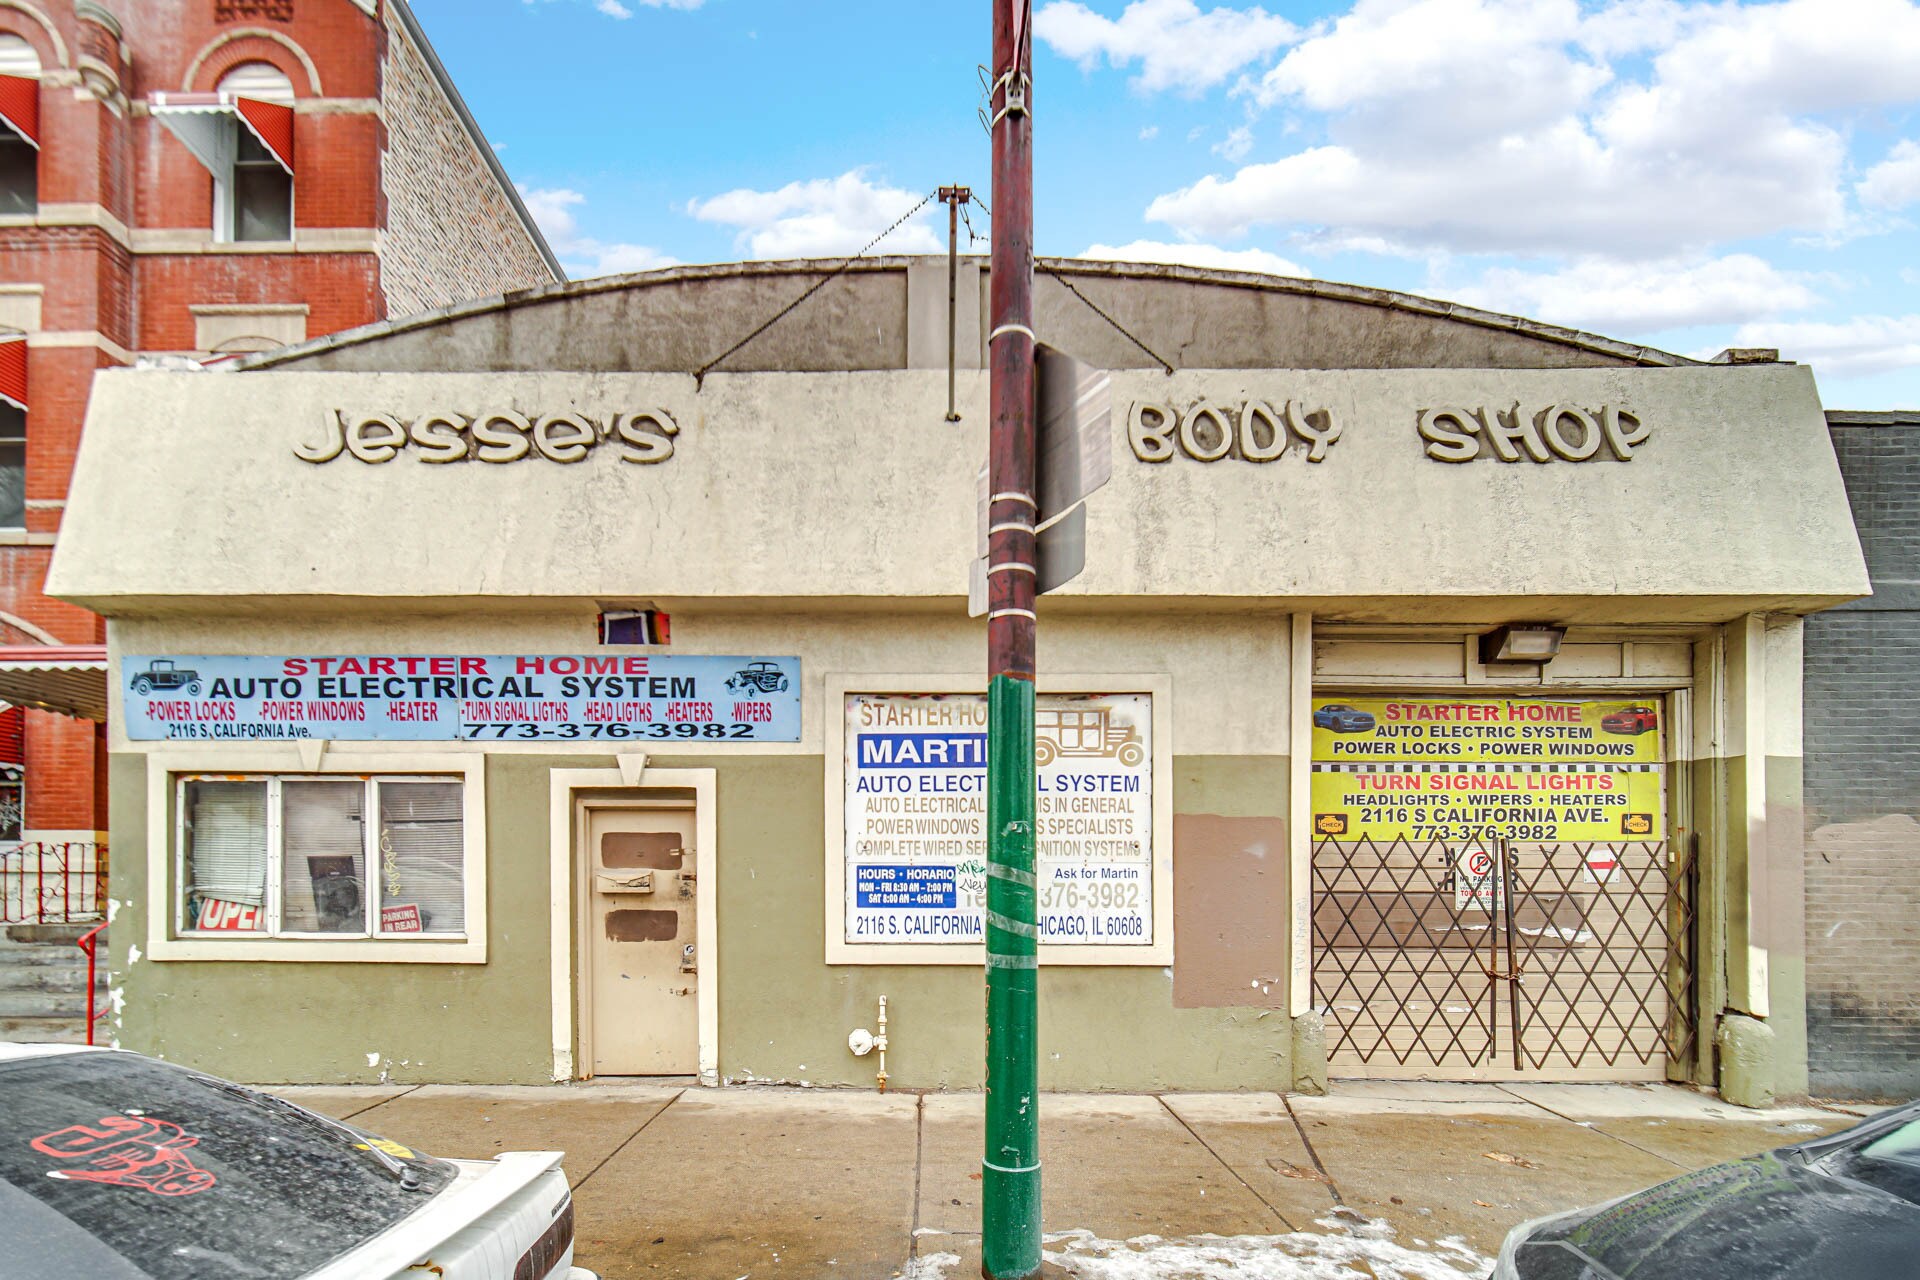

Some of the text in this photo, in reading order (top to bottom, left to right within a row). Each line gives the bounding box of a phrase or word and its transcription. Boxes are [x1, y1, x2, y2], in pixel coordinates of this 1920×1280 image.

[1128, 400, 1651, 463] BODY SHOP
[283, 657, 649, 676] STARTER HOME
[209, 677, 695, 699] AUTO ELECTRICAL SYSTEM
[195, 701, 236, 721] LOCKS
[307, 701, 365, 721] WINDOWS
[494, 701, 529, 721] SIGNAL
[533, 701, 568, 722] LIGTHS
[617, 701, 652, 722] LIGTHS
[860, 702, 987, 726] STARTER HO
[1385, 704, 1582, 723] STARTER HOME
[169, 724, 196, 737] 2116
[214, 724, 284, 738] CALIFORNIA
[288, 724, 312, 738] Ave.
[463, 723, 754, 738] 773-376-3982
[1375, 726, 1593, 739] AUTO ELECTRIC SYSTEM
[863, 739, 987, 764] MARTI
[1334, 742, 1635, 756] POWER LOCKS POWER WINDOWS
[856, 775, 912, 793] AUTO
[1056, 774, 1139, 792] SYSTEM
[1356, 775, 1613, 790] TURN SIGNAL LIGHTS
[866, 797, 900, 813] AUTO
[904, 797, 985, 814] ELECTRICAL
[1055, 797, 1067, 813] IN
[1072, 797, 1134, 814] GENERAL
[1344, 794, 1627, 806] HEADLIGHTS WIPERS HEATERS
[1361, 808, 1609, 823] 2116 S CALIFORNIA AVE.
[866, 818, 914, 835] POWER
[916, 818, 980, 835] WINDOWS
[1049, 818, 1133, 835] SPECIALISTS
[1412, 825, 1557, 840] 773-376-3982
[856, 840, 920, 856] COMPLETE
[923, 840, 962, 856] WIRED
[1084, 841, 1140, 857] SYSTEMS
[859, 869, 895, 880] HOURS
[906, 869, 954, 880] HORARIO
[1055, 868, 1138, 879] Ask for Martin
[859, 882, 874, 892] MON
[881, 882, 892, 892] FRI
[909, 882, 919, 892] AM
[926, 882, 941, 892] 7:00
[942, 882, 953, 892] PM
[868, 893, 881, 904] SAT
[899, 893, 910, 904] AM
[917, 893, 932, 904] 4:00
[933, 893, 943, 904] PM
[382, 909, 416, 922] PARKING
[395, 920, 418, 931] REAR
[857, 915, 1143, 936] 2116 S. CALIFORNIA HICAGO, IL 60608
